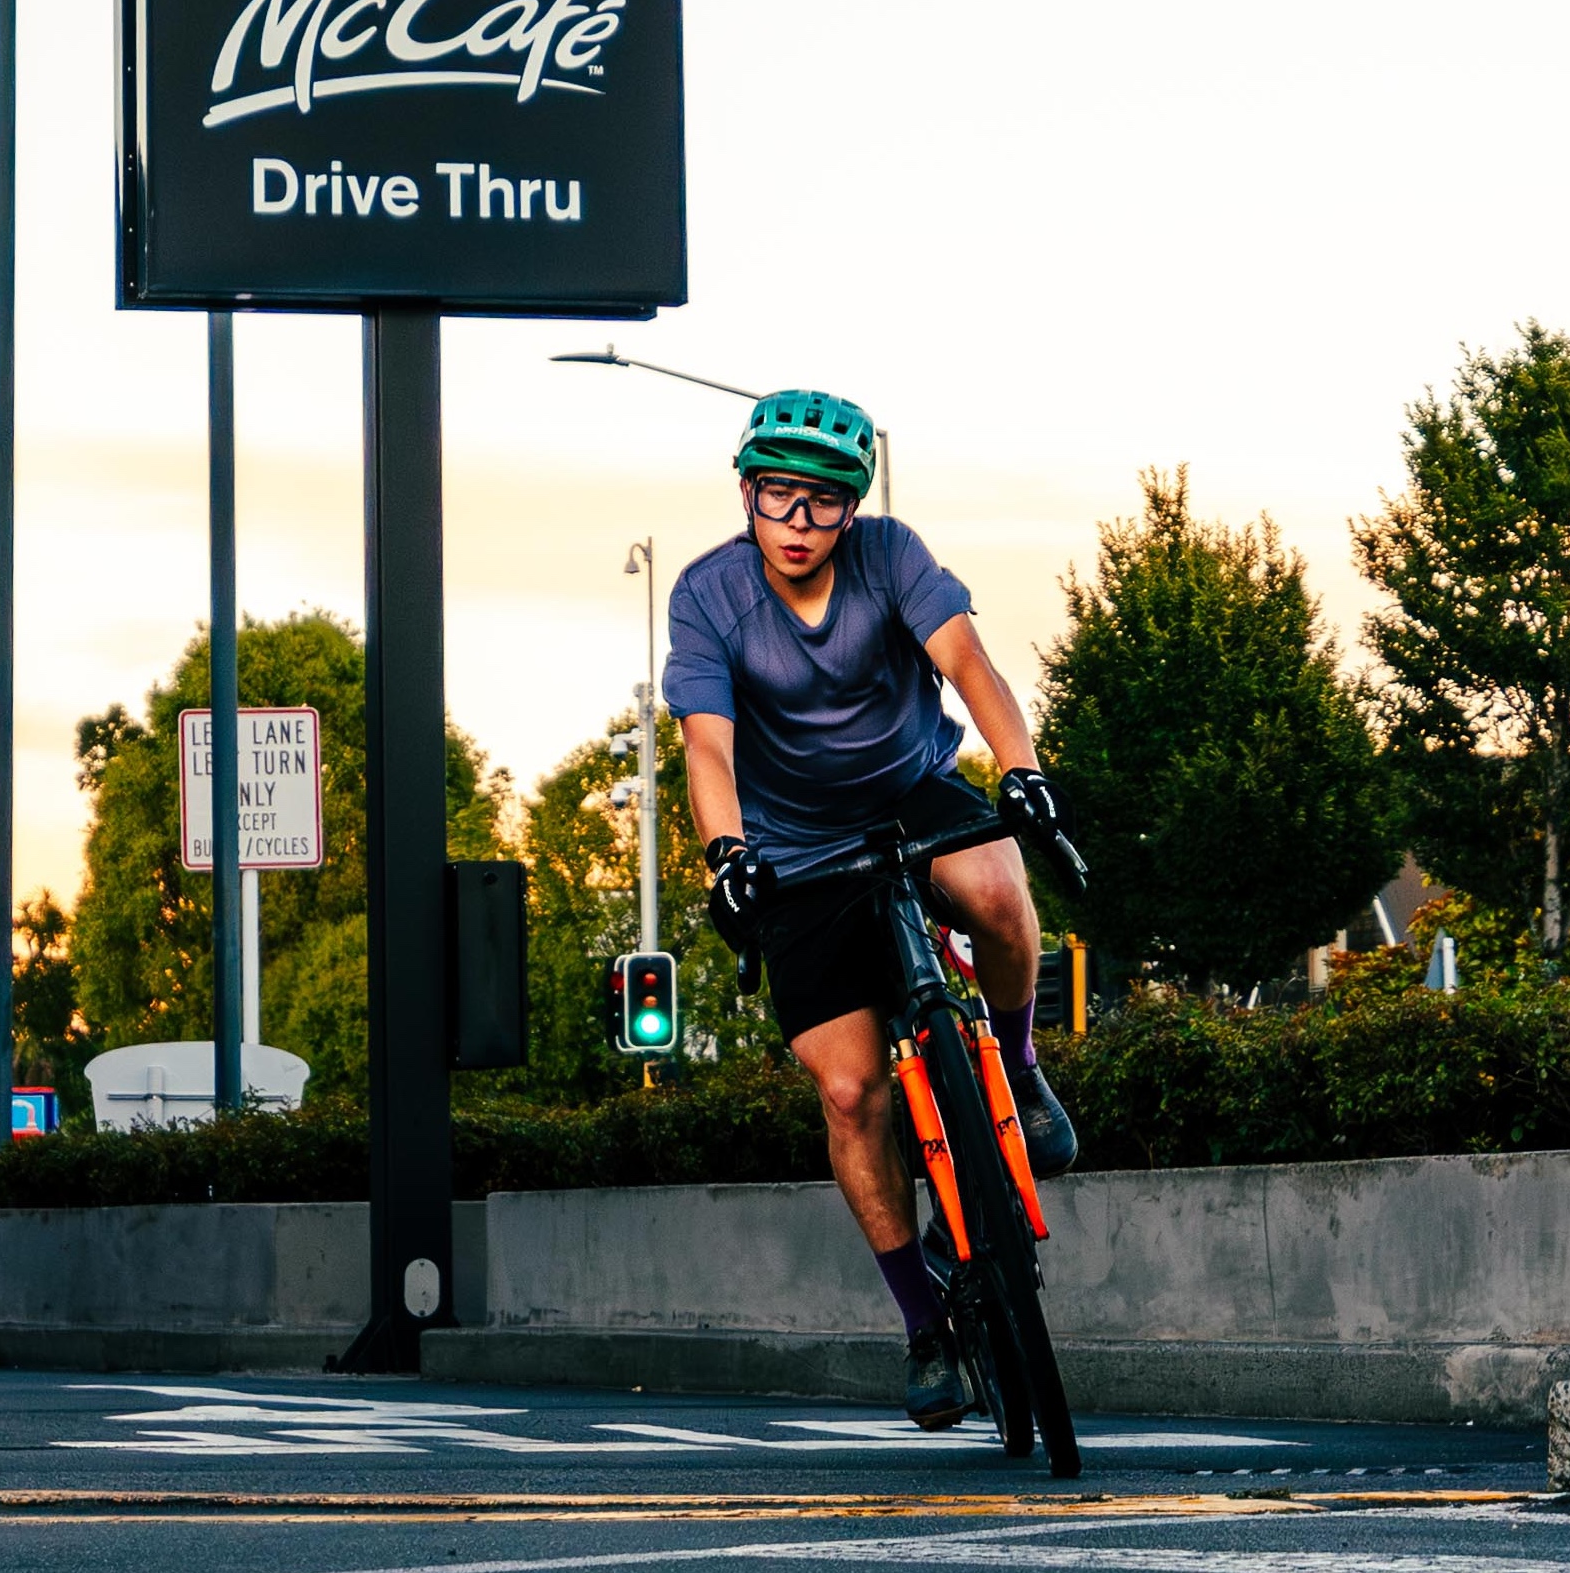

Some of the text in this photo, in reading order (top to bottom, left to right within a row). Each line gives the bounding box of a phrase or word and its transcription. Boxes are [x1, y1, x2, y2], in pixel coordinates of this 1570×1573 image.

[252, 157, 582, 221] Drive Thru
[253, 720, 306, 745] LANE
[253, 750, 306, 775] TURN
[240, 781, 276, 806] NLY
[238, 812, 277, 831] CEPT
